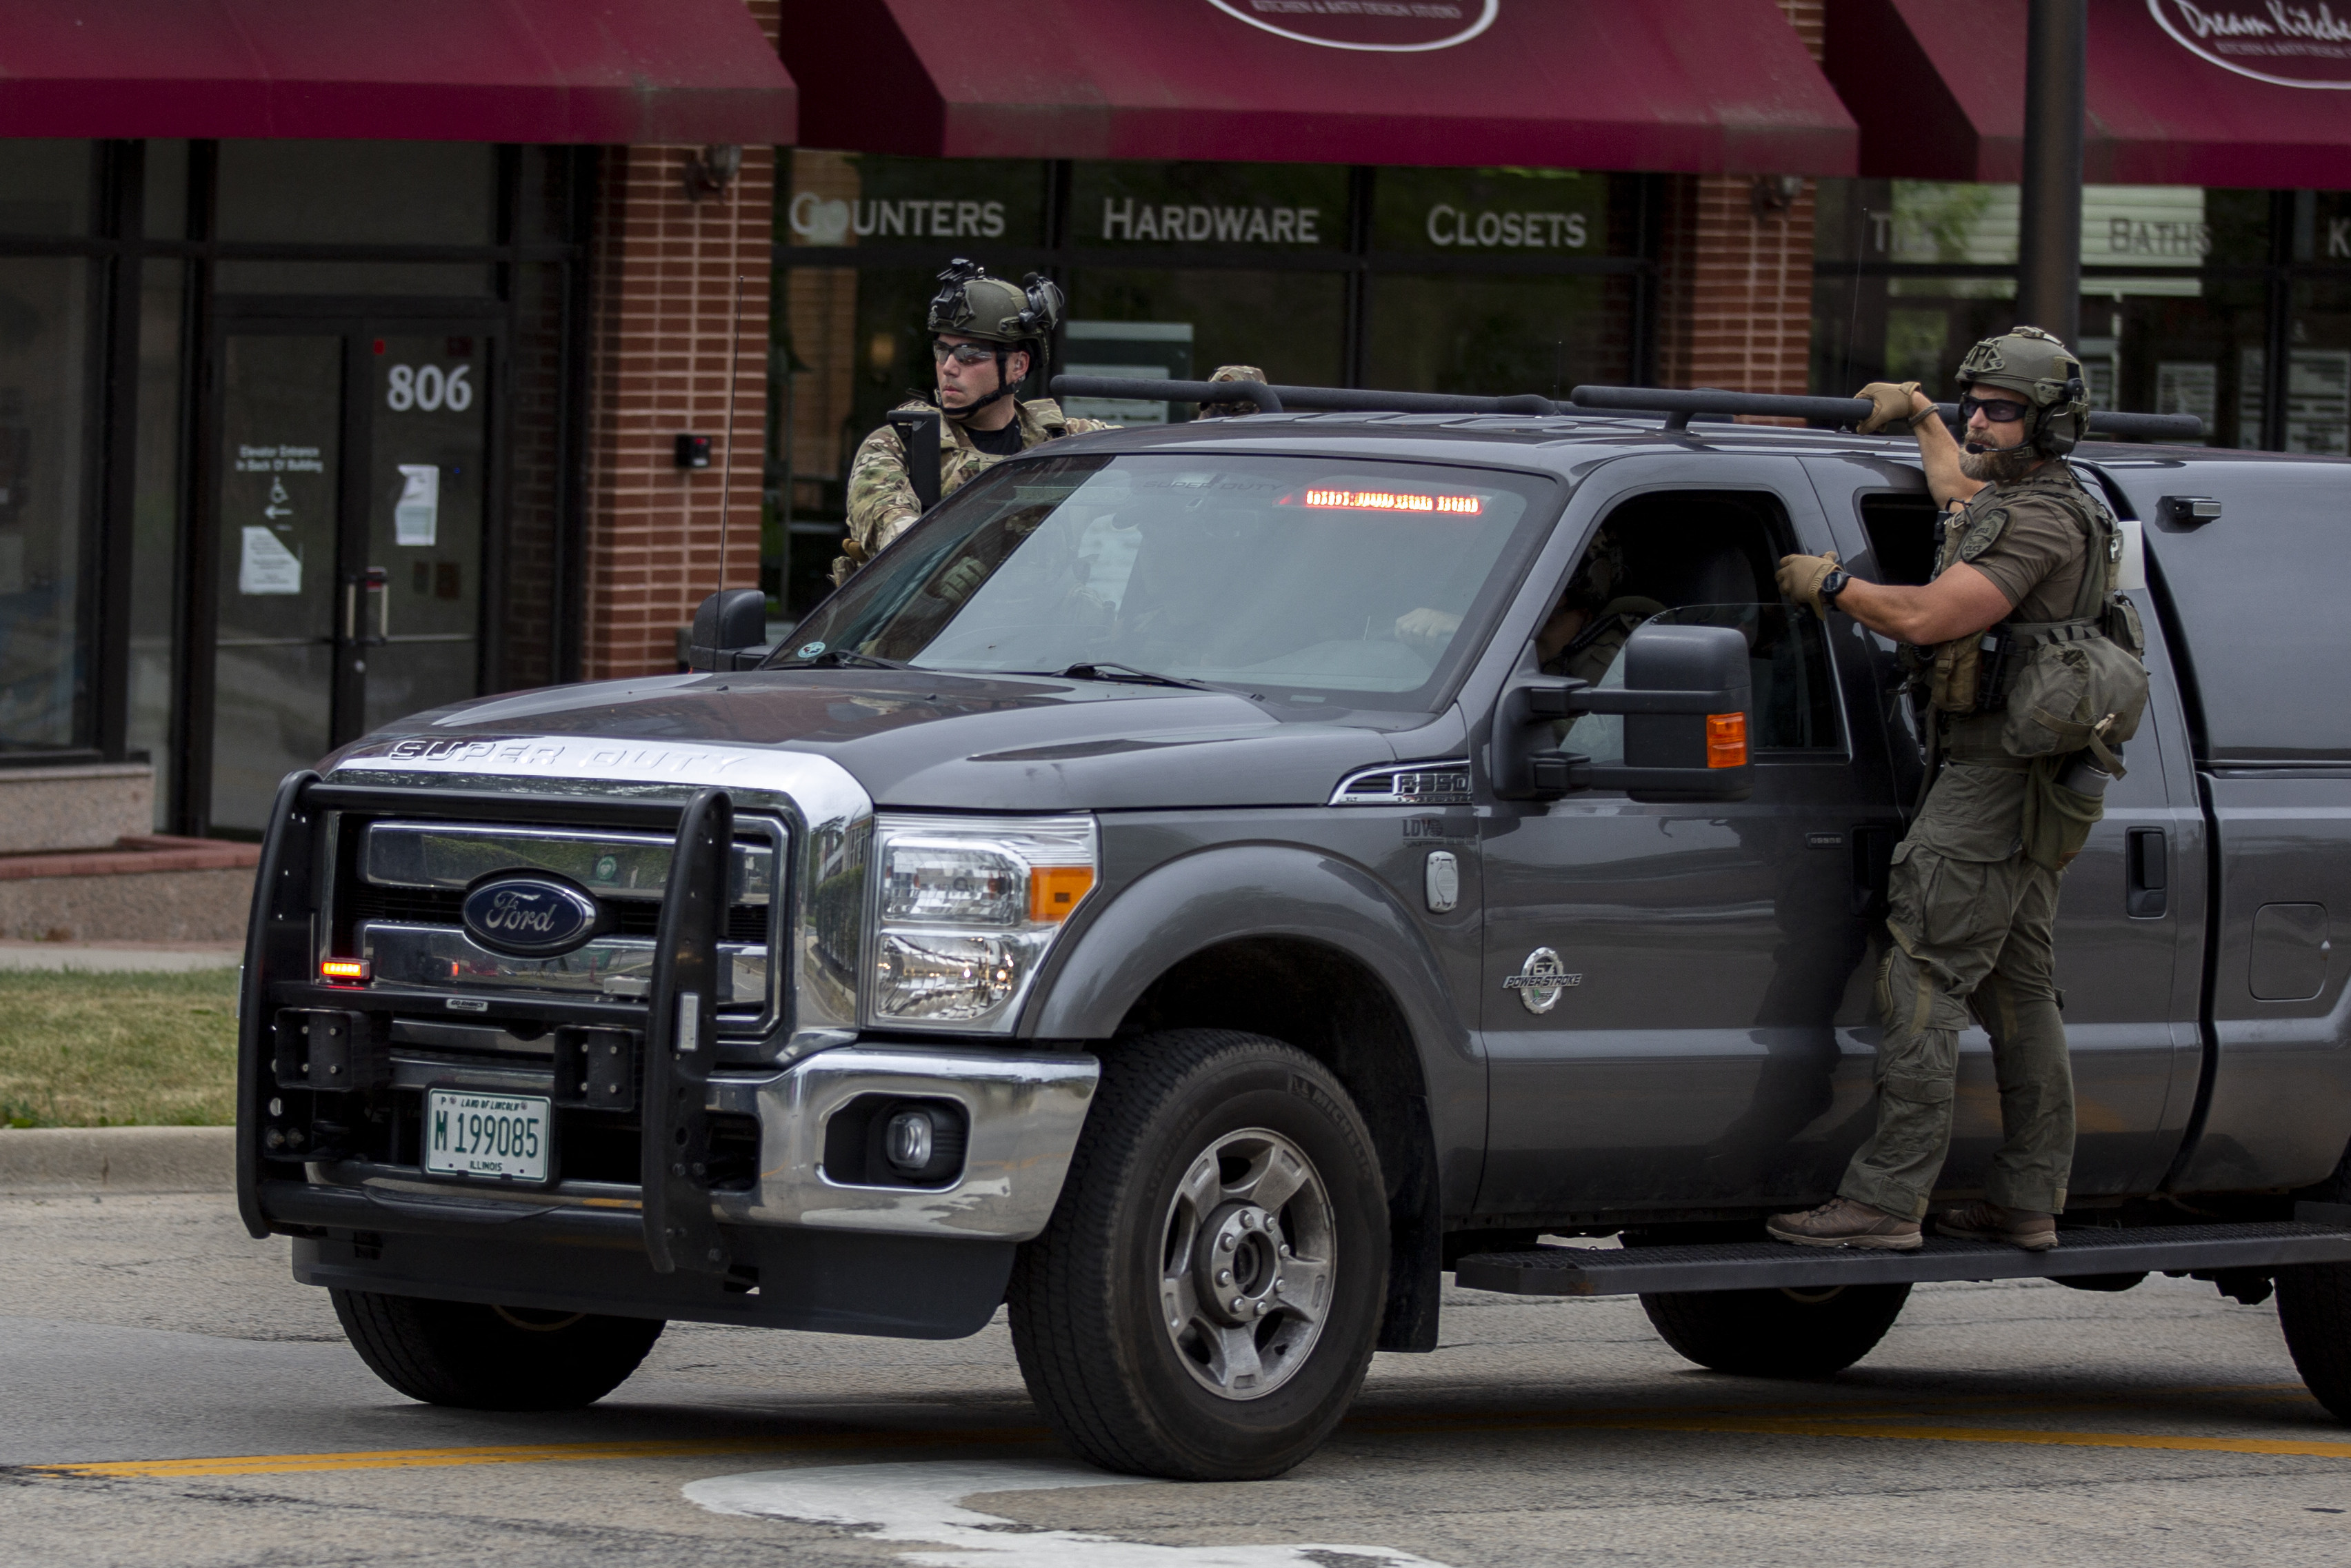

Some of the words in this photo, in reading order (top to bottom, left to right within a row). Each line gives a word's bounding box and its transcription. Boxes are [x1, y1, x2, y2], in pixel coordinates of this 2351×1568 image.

[788, 191, 1006, 238] COUNTERS
[1103, 197, 1320, 244] HARDWARE
[1425, 203, 1586, 248] CLOSETS
[2109, 217, 2212, 256] BATHS
[387, 363, 472, 412] 806
[388, 740, 566, 765] SUPER
[577, 749, 749, 773] DUTY
[485, 890, 557, 932] Ford
[461, 1098, 480, 1108] LAND
[481, 1100, 489, 1109] OF
[490, 1101, 520, 1111] LINCOLN
[470, 1160, 503, 1171] ILLINOIS
